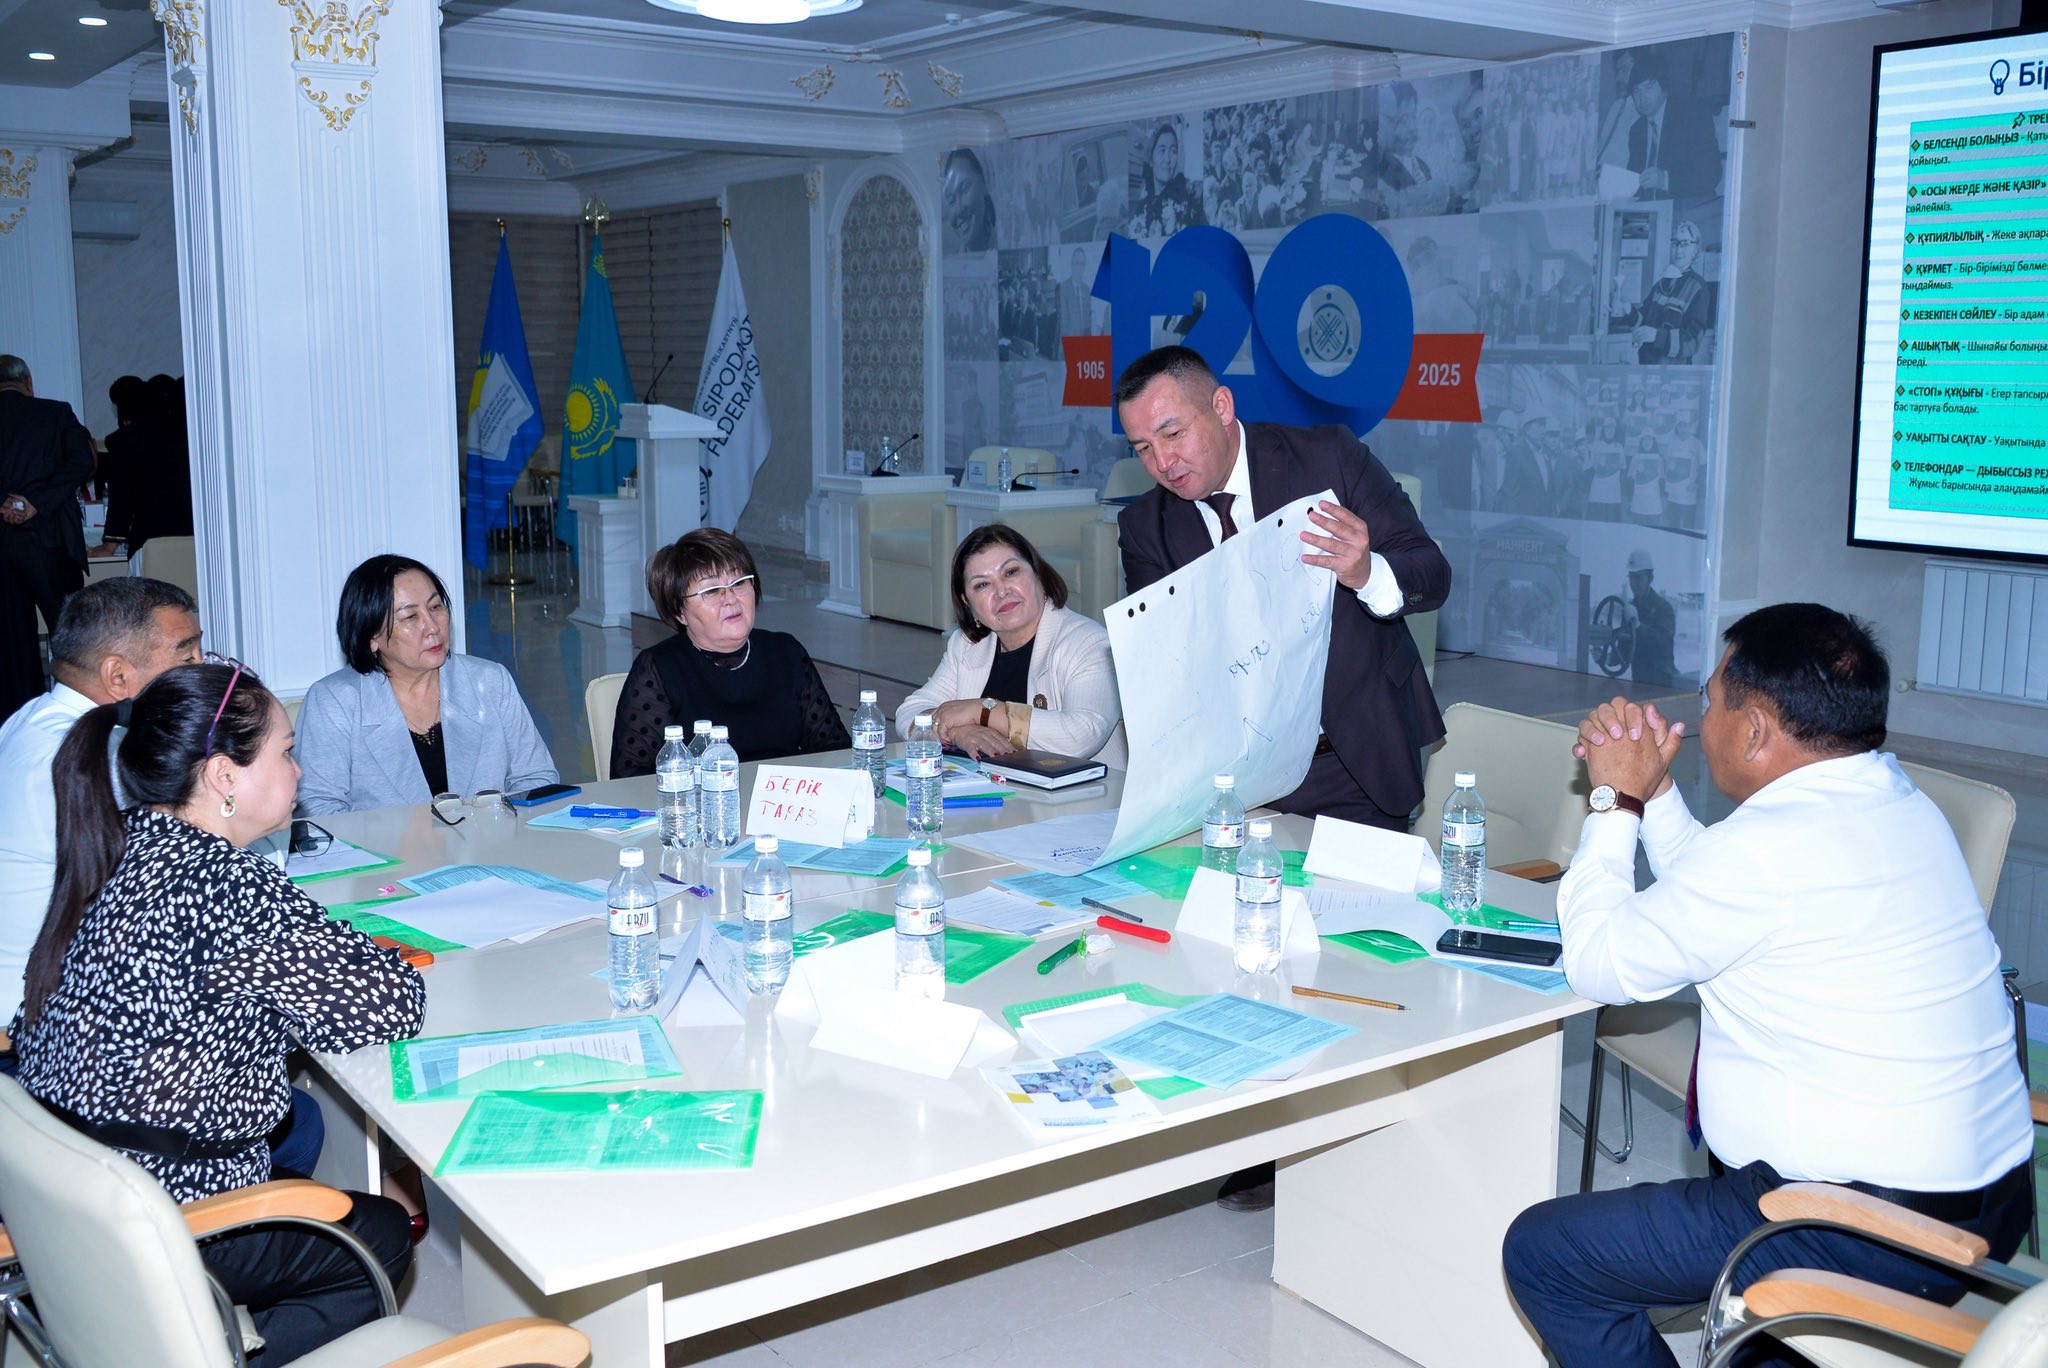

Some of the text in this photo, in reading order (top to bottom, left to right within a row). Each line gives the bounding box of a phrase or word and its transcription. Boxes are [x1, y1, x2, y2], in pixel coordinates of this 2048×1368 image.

[1923, 138, 1967, 150] БЕЛСЕНДІ
[1970, 132, 2018, 146] БОЛЫҢЫЗ
[1921, 179, 2047, 196] «ОСЫ ЖЕРДЕ ЖӘНЕ ҚАЗІР»
[1992, 230, 2016, 240] Жеке
[1913, 310, 1957, 320] КЕЗЕКПЕН
[1960, 307, 1997, 320] СӨЙЛЕУ
[2004, 309, 2018, 321] Бір
[2021, 311, 2044, 320] адам
[1911, 341, 1960, 353] АШЫҚТЫҚ
[1968, 341, 2007, 351] Шынайы
[1076, 361, 1105, 379] 1905
[1418, 363, 1461, 386] 2025
[1908, 387, 1942, 397] «СТОП»
[1991, 388, 2011, 400] Егер
[1894, 402, 1908, 412] бас
[1906, 432, 1949, 444] УАҚЫТТЫ
[1951, 434, 1987, 446] САҚТАУ
[1904, 462, 1964, 475] ТЕЛЕФОНДАР
[1977, 465, 2032, 478] ДЫБЫССЫЗ
[626, 912, 649, 927] ARZU
